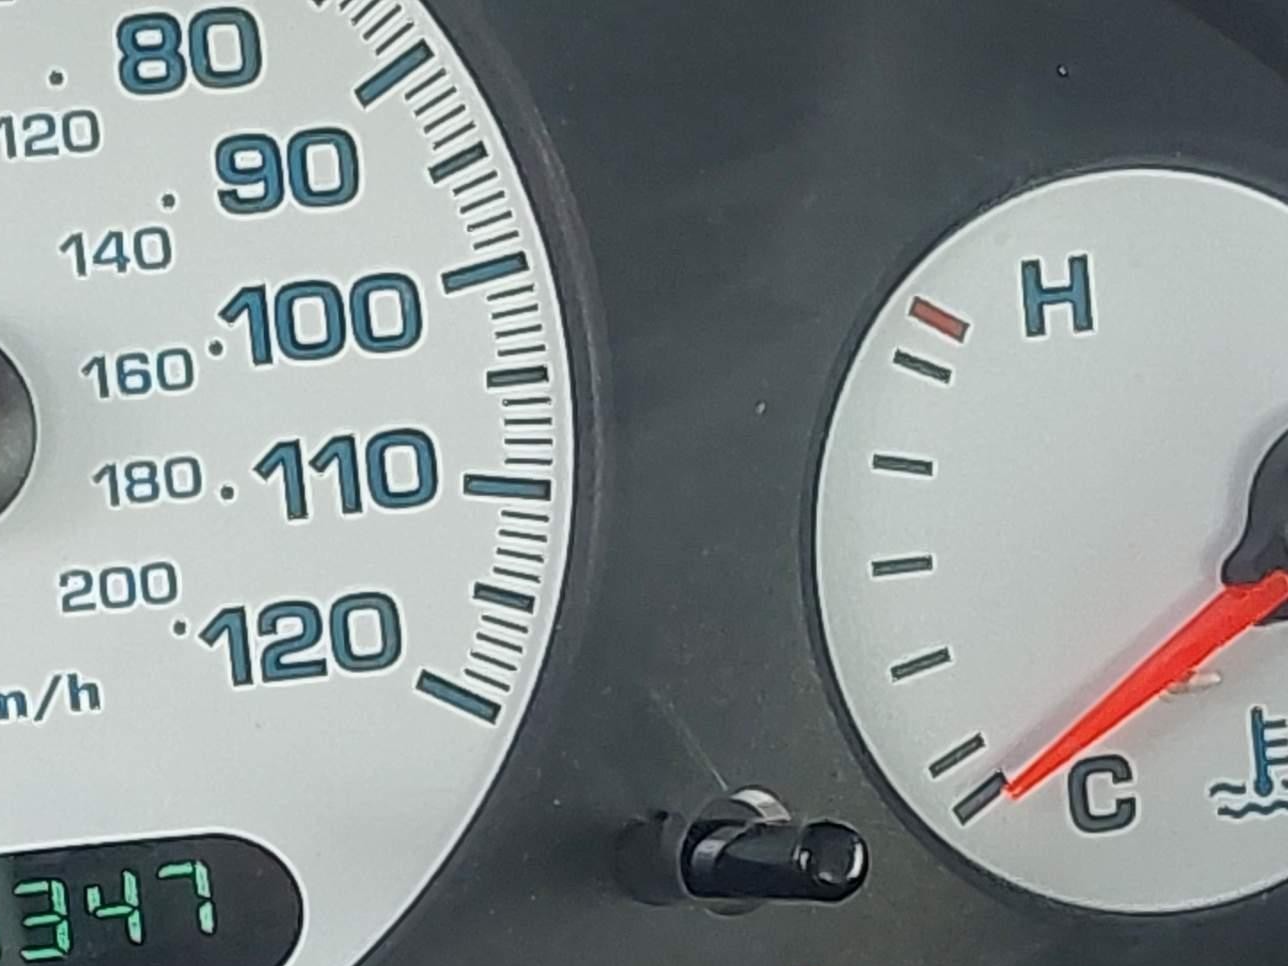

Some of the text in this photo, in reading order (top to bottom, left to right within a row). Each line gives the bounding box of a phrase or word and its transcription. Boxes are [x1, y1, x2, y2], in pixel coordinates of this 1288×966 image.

[116, 7, 262, 95] 80
[215, 127, 359, 214] 90
[59, 227, 171, 276] 140
[218, 273, 423, 366] 100
[1021, 254, 1093, 337] H
[81, 348, 193, 398] 160
[92, 457, 201, 506] 180
[253, 428, 438, 520] 110
[59, 562, 177, 612] 200
[199, 592, 402, 686] 120
[1067, 754, 1136, 832] C
